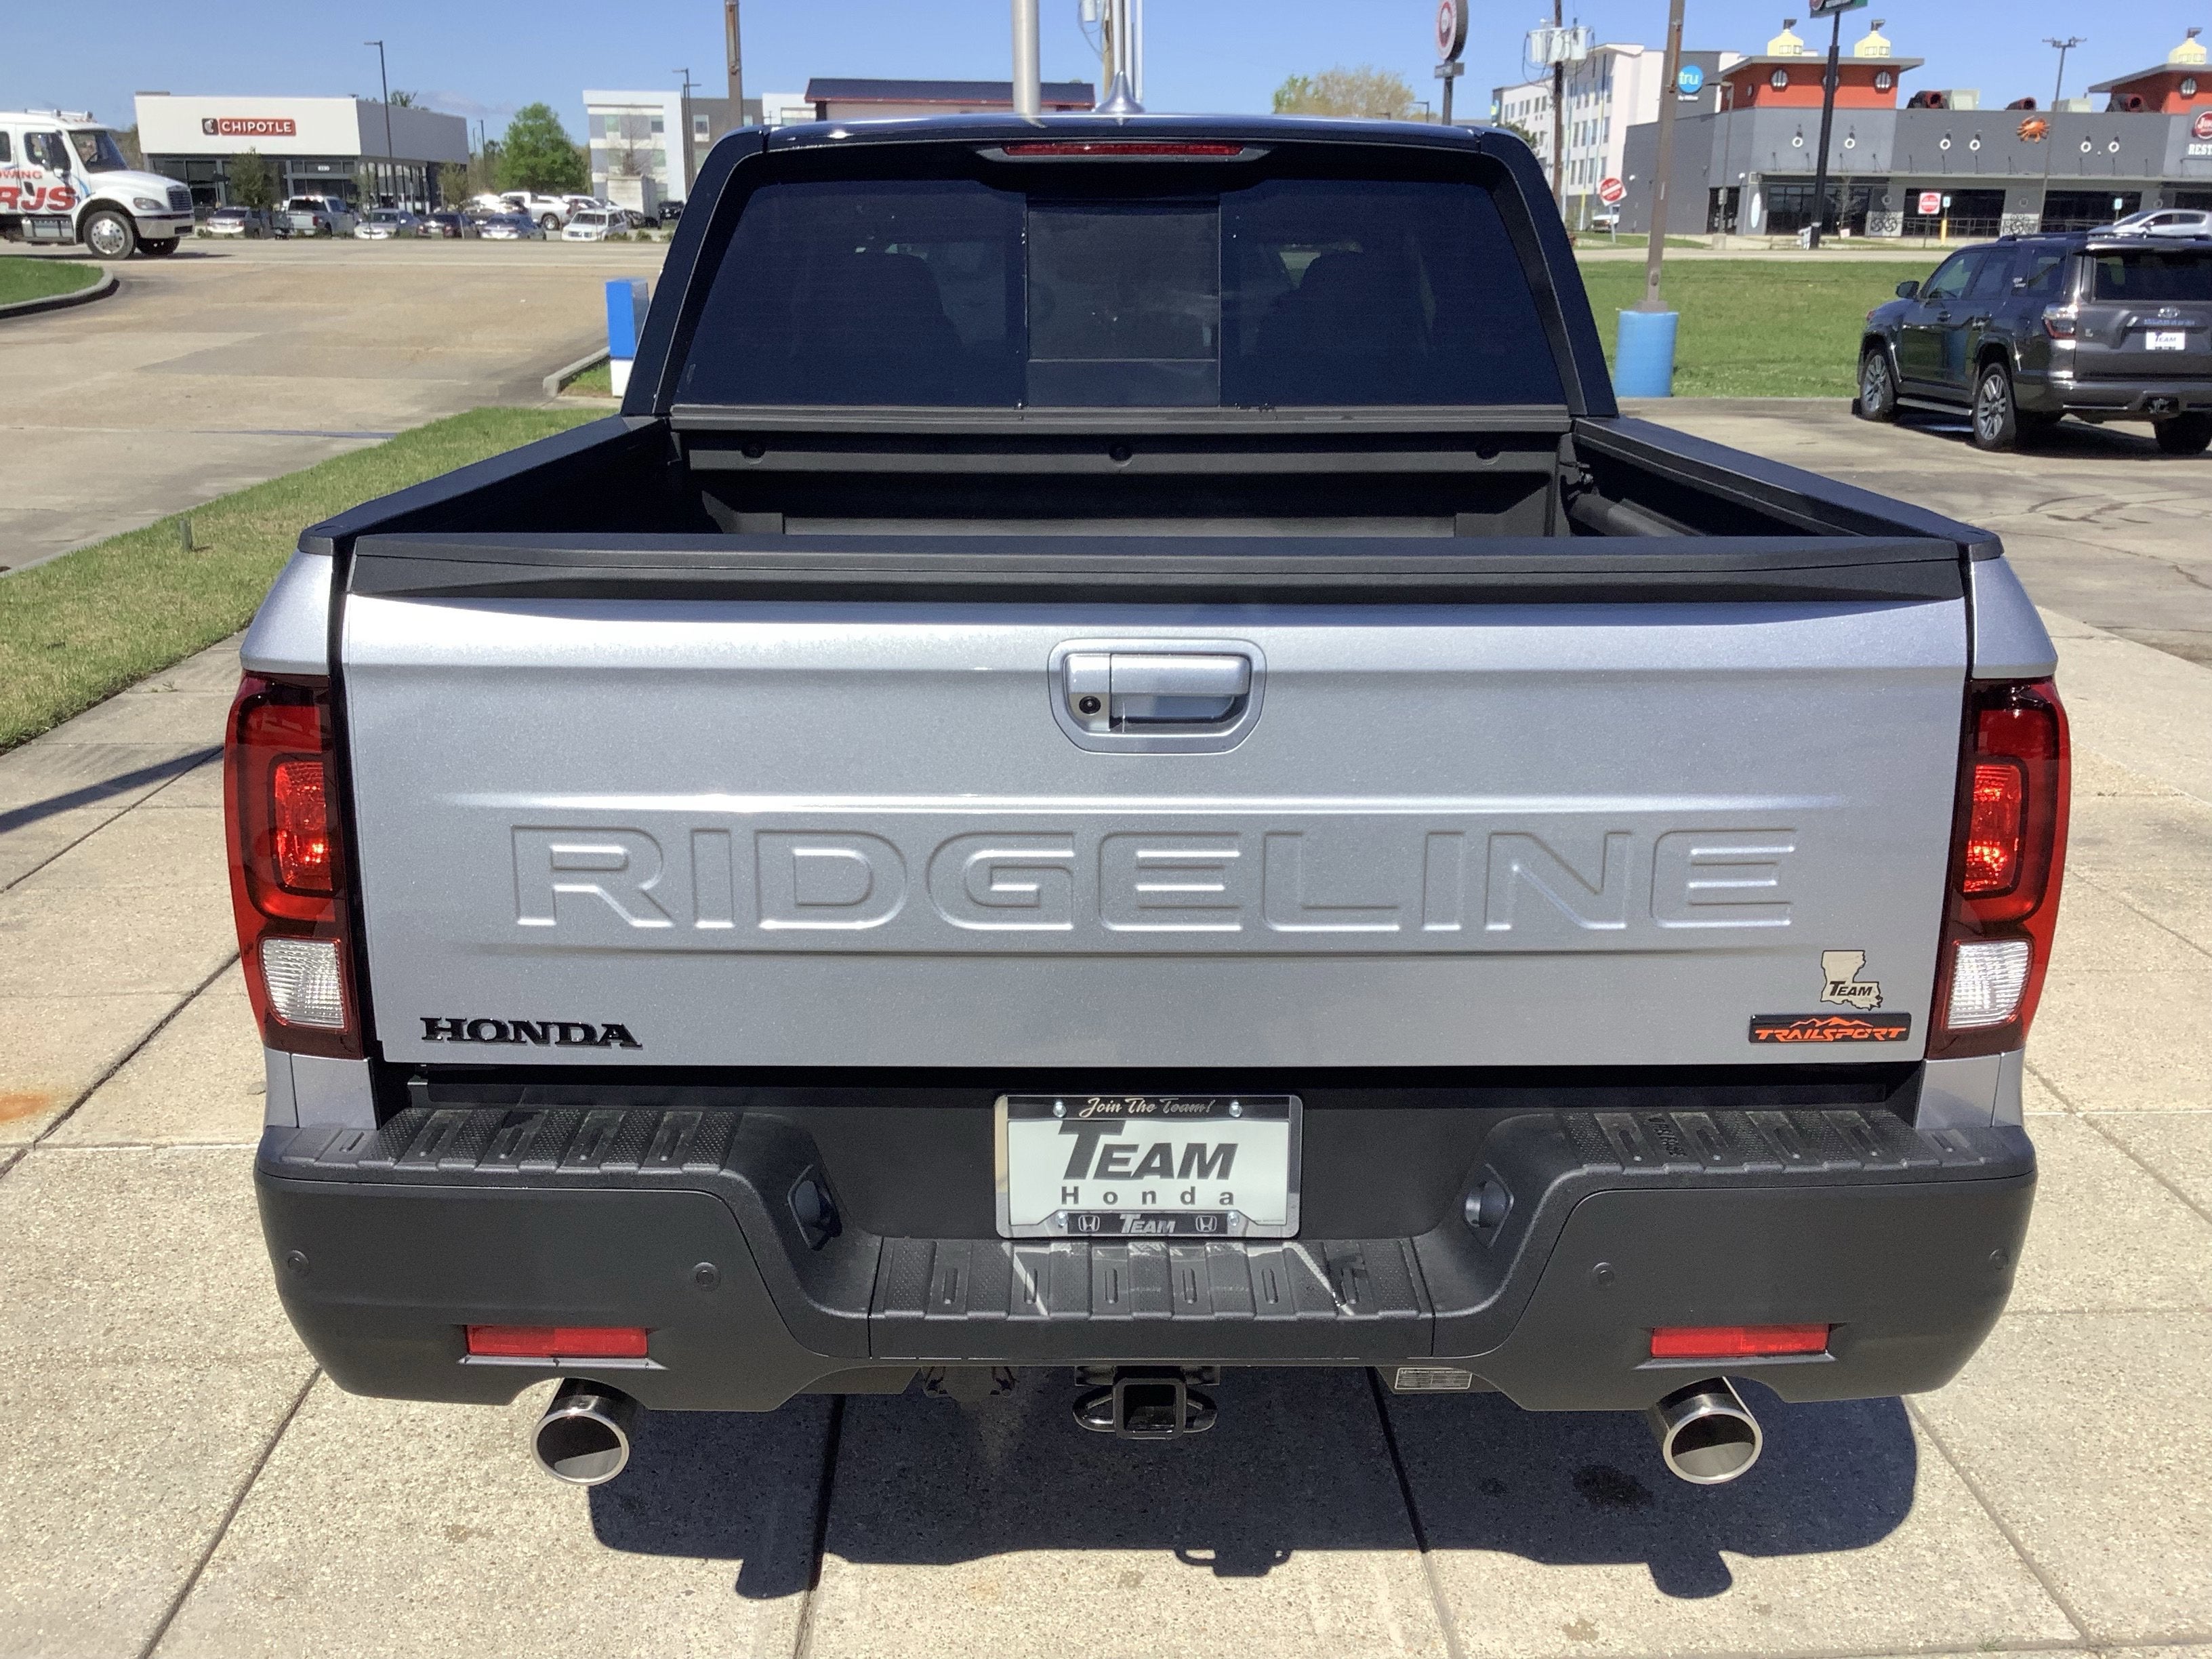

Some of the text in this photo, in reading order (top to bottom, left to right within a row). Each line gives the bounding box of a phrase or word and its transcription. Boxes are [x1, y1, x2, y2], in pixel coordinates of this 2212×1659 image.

[1679, 71, 1699, 85] tru
[222, 121, 292, 133] CHIPOTLE
[0, 170, 43, 179] WING
[510, 824, 1796, 932] RIDGELINE
[1829, 981, 1873, 996] TEAM
[419, 1017, 643, 1048] HONDA
[1755, 1027, 1907, 1042] TRAILSPORT
[1079, 1097, 1216, 1118] Join The Team!
[1057, 1120, 1239, 1181] TEAM
[1061, 1186, 1235, 1206] Honda
[1120, 1213, 1176, 1233] TEAM
